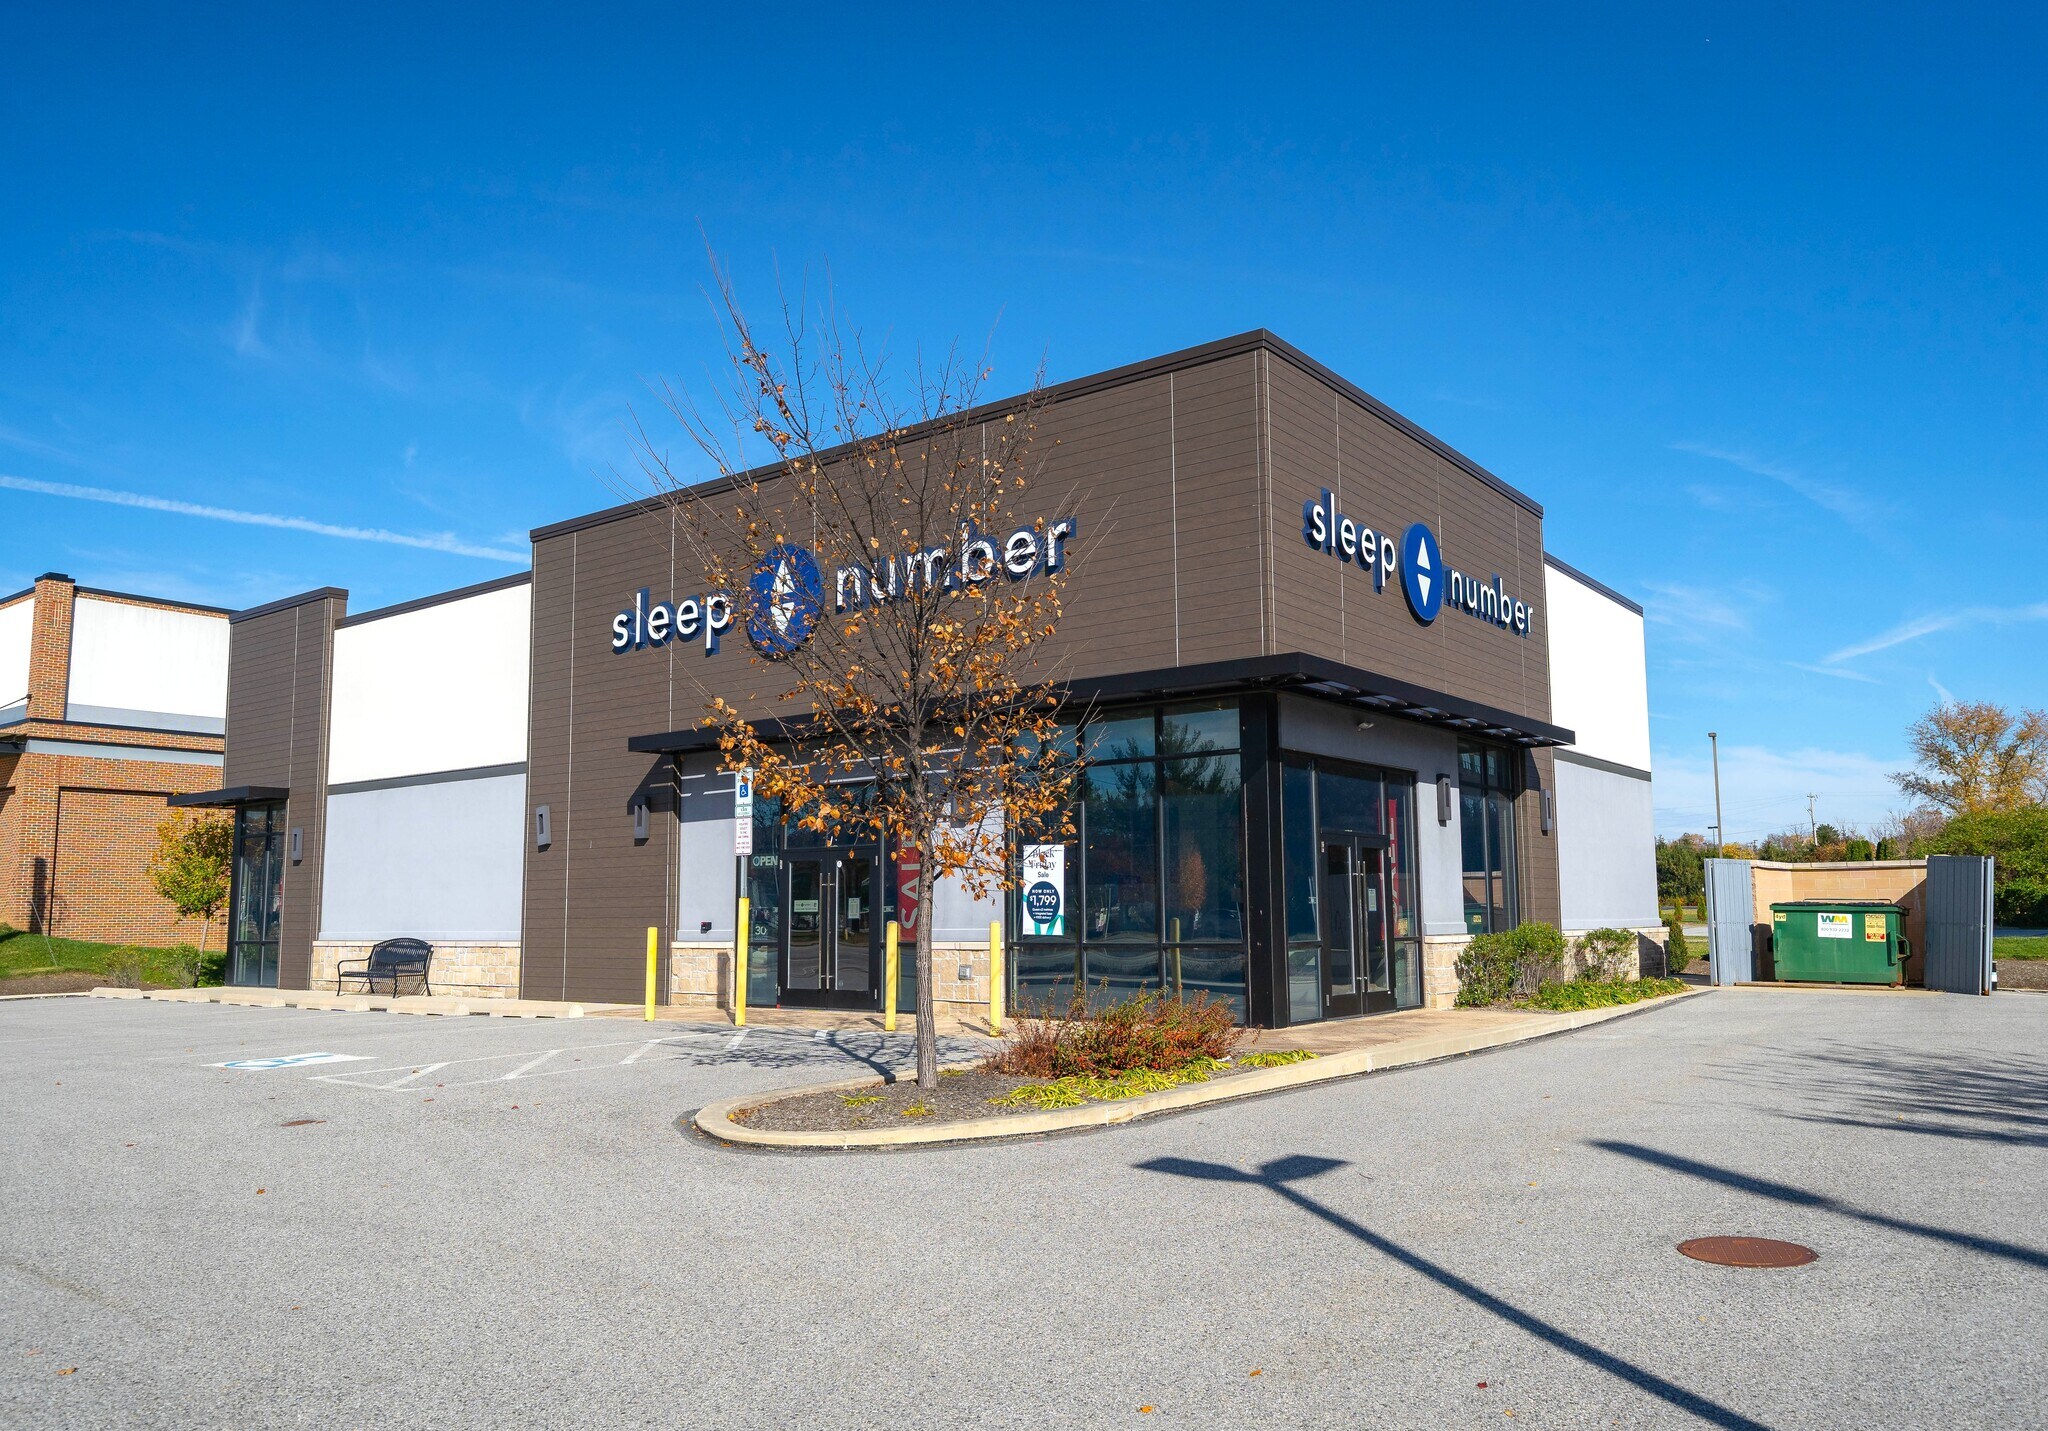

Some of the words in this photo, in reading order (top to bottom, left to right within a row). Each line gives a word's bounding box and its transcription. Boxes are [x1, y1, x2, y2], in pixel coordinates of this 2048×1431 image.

[1307, 490, 1397, 588] sleep
[1449, 567, 1534, 634] number
[612, 590, 733, 652] sleep
[836, 519, 1071, 608] number
[753, 856, 778, 866] OPEN
[1030, 895, 1057, 907] $1,799
[1821, 915, 1848, 923] WM
